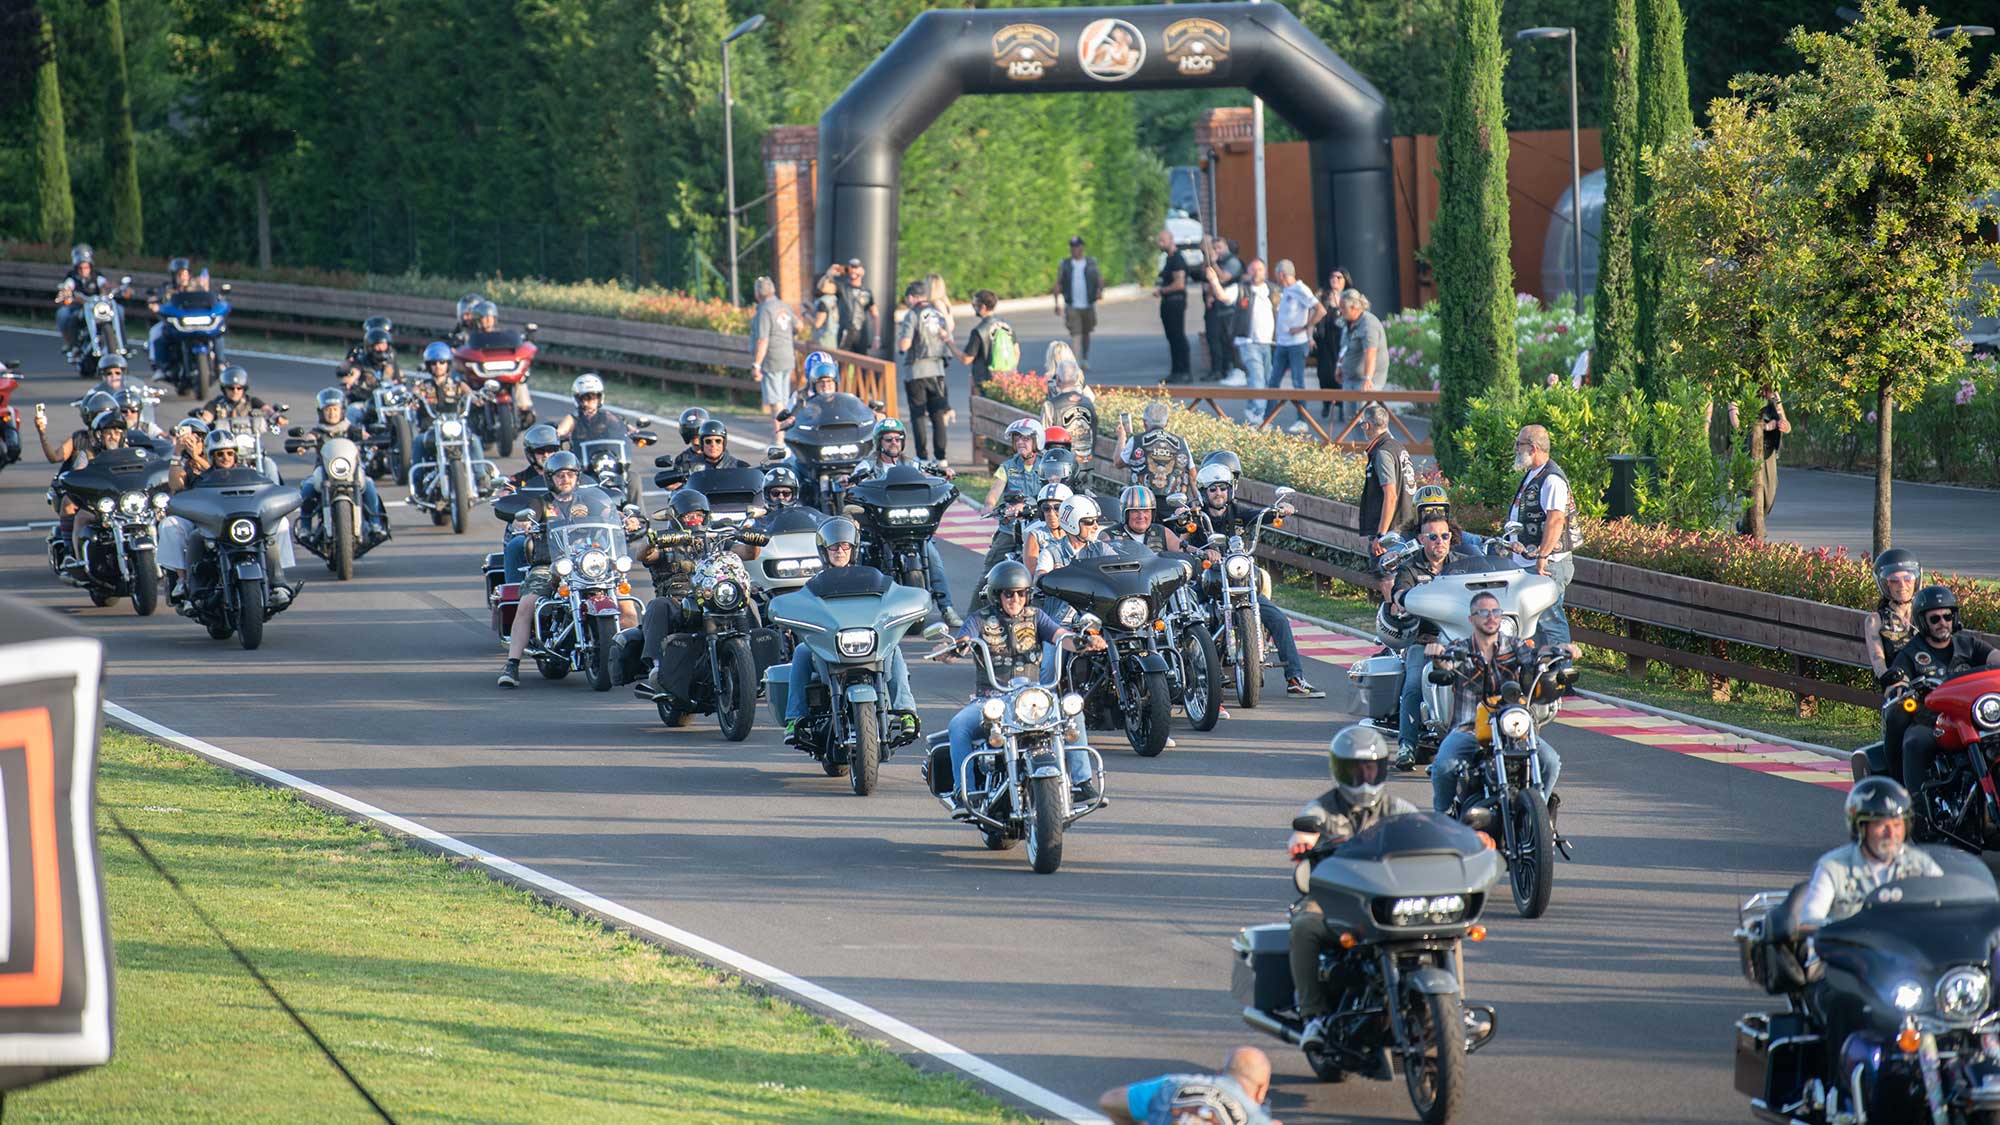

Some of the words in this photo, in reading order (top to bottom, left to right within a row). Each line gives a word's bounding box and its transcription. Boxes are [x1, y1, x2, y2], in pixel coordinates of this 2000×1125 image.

[1008, 60, 1043, 76] HOG
[1180, 55, 1214, 71] HOG
[1153, 447, 1170, 457] HOG
[743, 531, 765, 543] 9076
